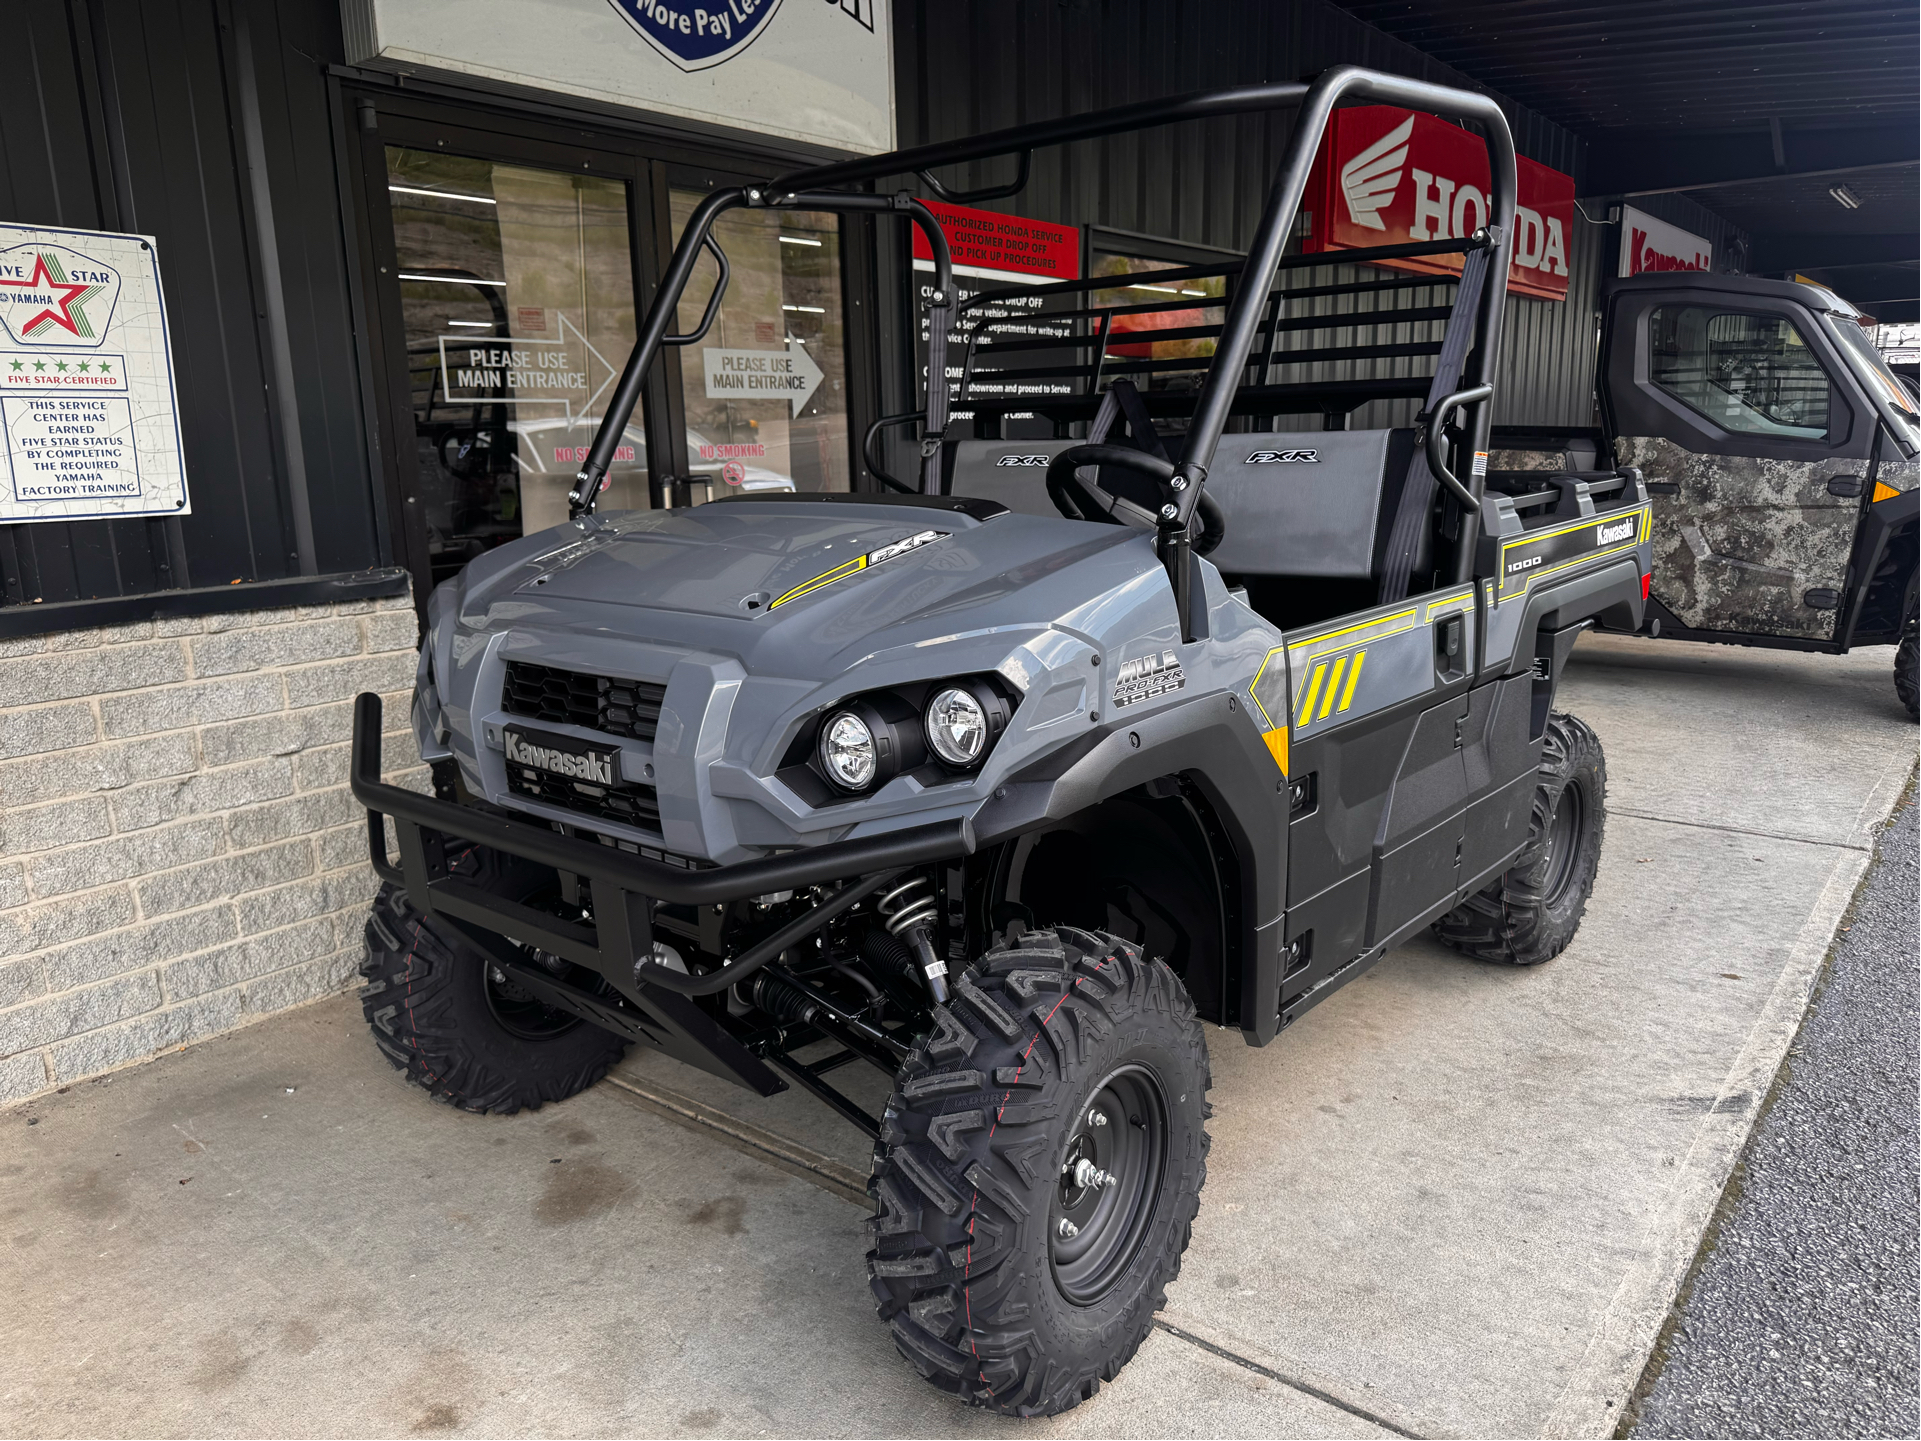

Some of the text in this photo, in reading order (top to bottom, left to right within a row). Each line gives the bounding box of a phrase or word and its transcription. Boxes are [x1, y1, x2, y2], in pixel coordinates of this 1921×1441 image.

[694, 9, 732, 40] Pay
[727, 0, 760, 24] Le
[935, 213, 1063, 244] AUTHORIZED HONDA SERVICE
[1409, 168, 1569, 277] HODA
[954, 231, 1047, 254] CUSTOMER DROP OFF
[950, 246, 1057, 270] ND PICK UP PROCEDURES
[0, 265, 111, 284] IVE STAR
[10, 293, 54, 306] YAMAHA
[1028, 297, 1044, 309] OFF
[966, 308, 983, 318] your
[1027, 325, 1037, 334] for
[1038, 327, 1063, 338] write-up
[1063, 329, 1071, 337] at
[469, 349, 569, 369] PLEASE USE
[721, 356, 793, 373] PLEASE USE
[8, 375, 117, 385] FIVE STAR CERTIFIED
[457, 370, 588, 389] MAIN ENTRANCE
[713, 374, 806, 390] MAIN ENTRANCE
[968, 382, 1004, 393] showroom
[1004, 384, 1017, 393] and
[1018, 384, 1043, 395] proceed
[1043, 385, 1050, 393] to
[1051, 384, 1071, 394] Service
[28, 401, 107, 410] THIS SERVICE
[33, 413, 106, 422] CENTER HAS
[48, 425, 95, 434] EARNED
[22, 437, 123, 447] FIVE STAR STATUS
[27, 448, 122, 459] BY COMPLETING
[555, 447, 573, 462] NO
[700, 444, 765, 459] NO SMOKING
[1244, 449, 1321, 464] FXR
[33, 461, 119, 471] THE REQUIRED
[995, 455, 1050, 467] FXR
[54, 473, 104, 482] YAMAHA
[22, 483, 136, 496] FACTORY TRAINING
[1596, 517, 1634, 546] Kawasaki
[869, 530, 938, 565] FXR
[1507, 556, 1542, 573] 1000
[1116, 649, 1182, 687] MULE
[504, 731, 612, 785] Kawasaki
